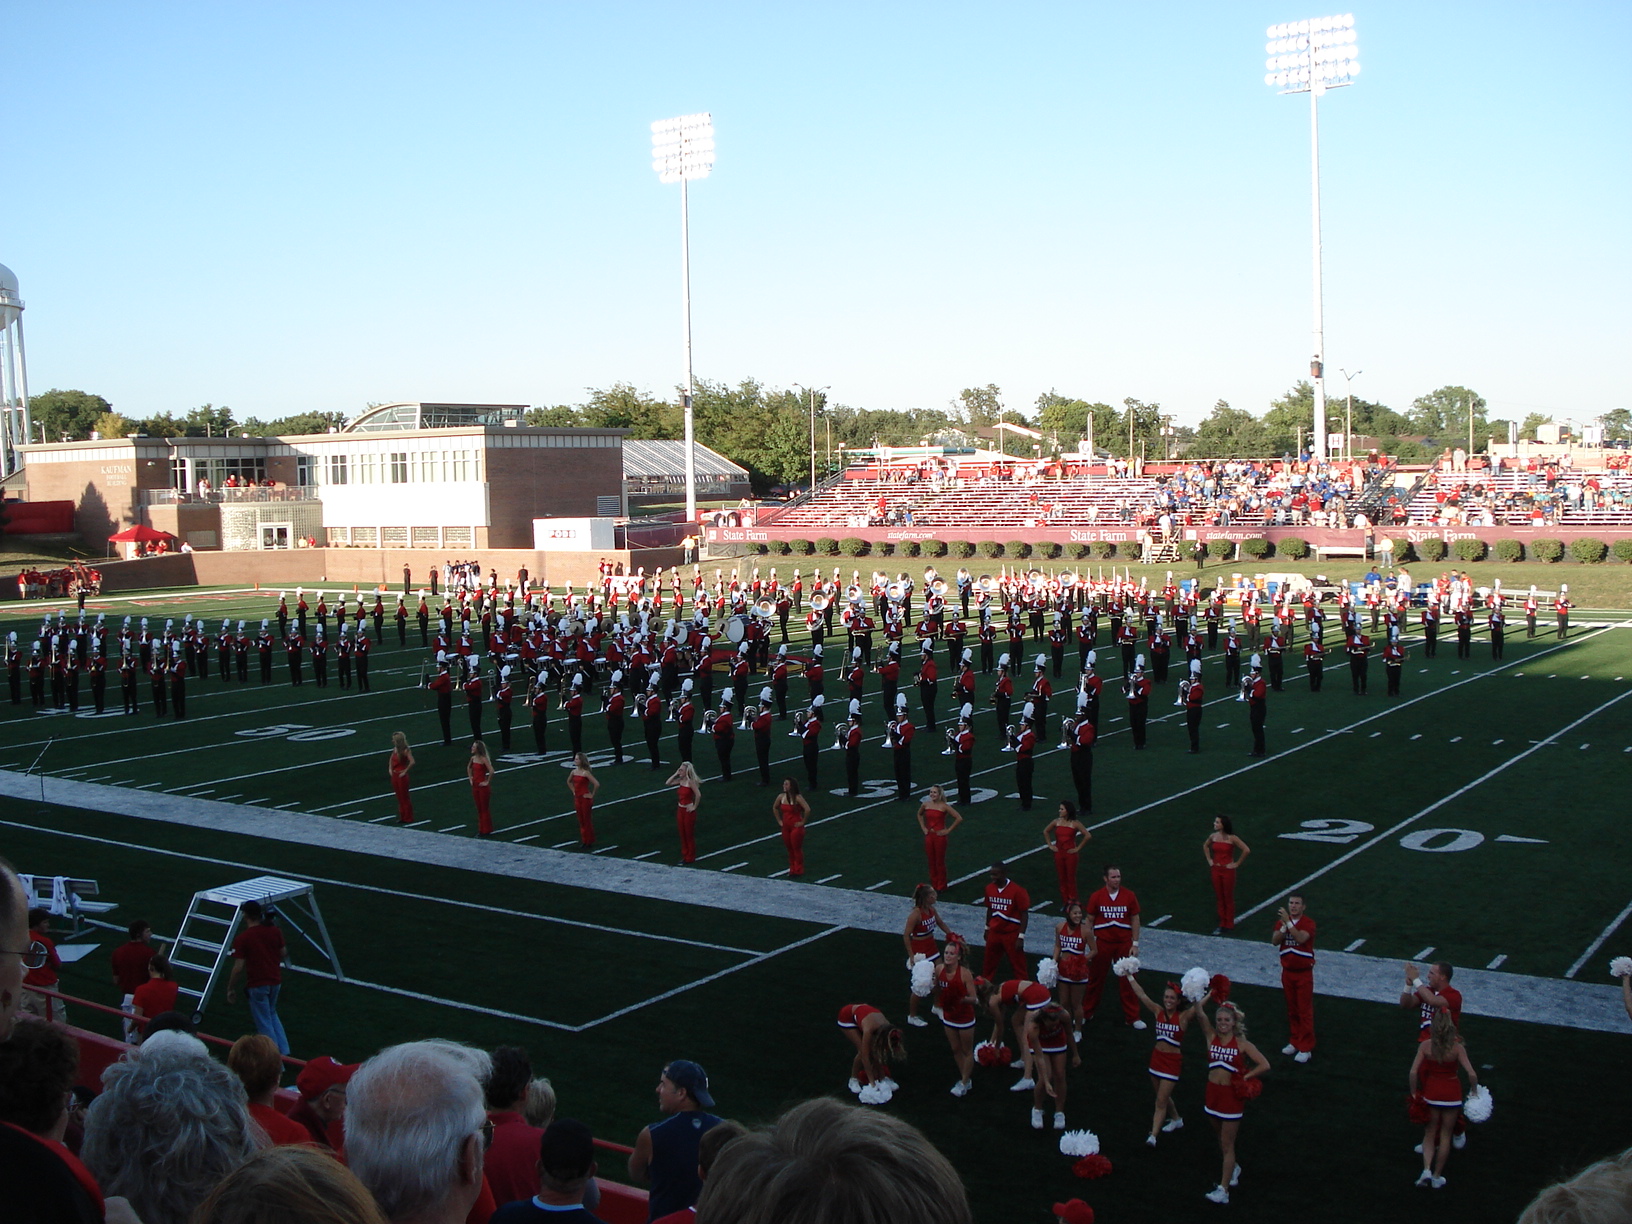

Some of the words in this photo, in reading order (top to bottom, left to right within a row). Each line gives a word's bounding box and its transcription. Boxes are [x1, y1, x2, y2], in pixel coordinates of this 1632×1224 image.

[1332, 436, 1340, 446] H
[100, 465, 132, 475] KAUFMAN
[723, 529, 744, 541] State
[745, 529, 768, 541] Farm
[1070, 529, 1097, 541] State
[1098, 529, 1127, 541] Farm
[1407, 529, 1440, 542] State
[1443, 529, 1476, 542] Farm
[988, 896, 1012, 905] ILLINOIS
[991, 903, 1008, 911] STATE
[1099, 905, 1128, 913] ILLINOIS
[1060, 941, 1078, 949] STATE
[1156, 1028, 1175, 1039] STATE
[1210, 1044, 1239, 1056] LLINOIS
[1210, 1052, 1234, 1063] STATE
